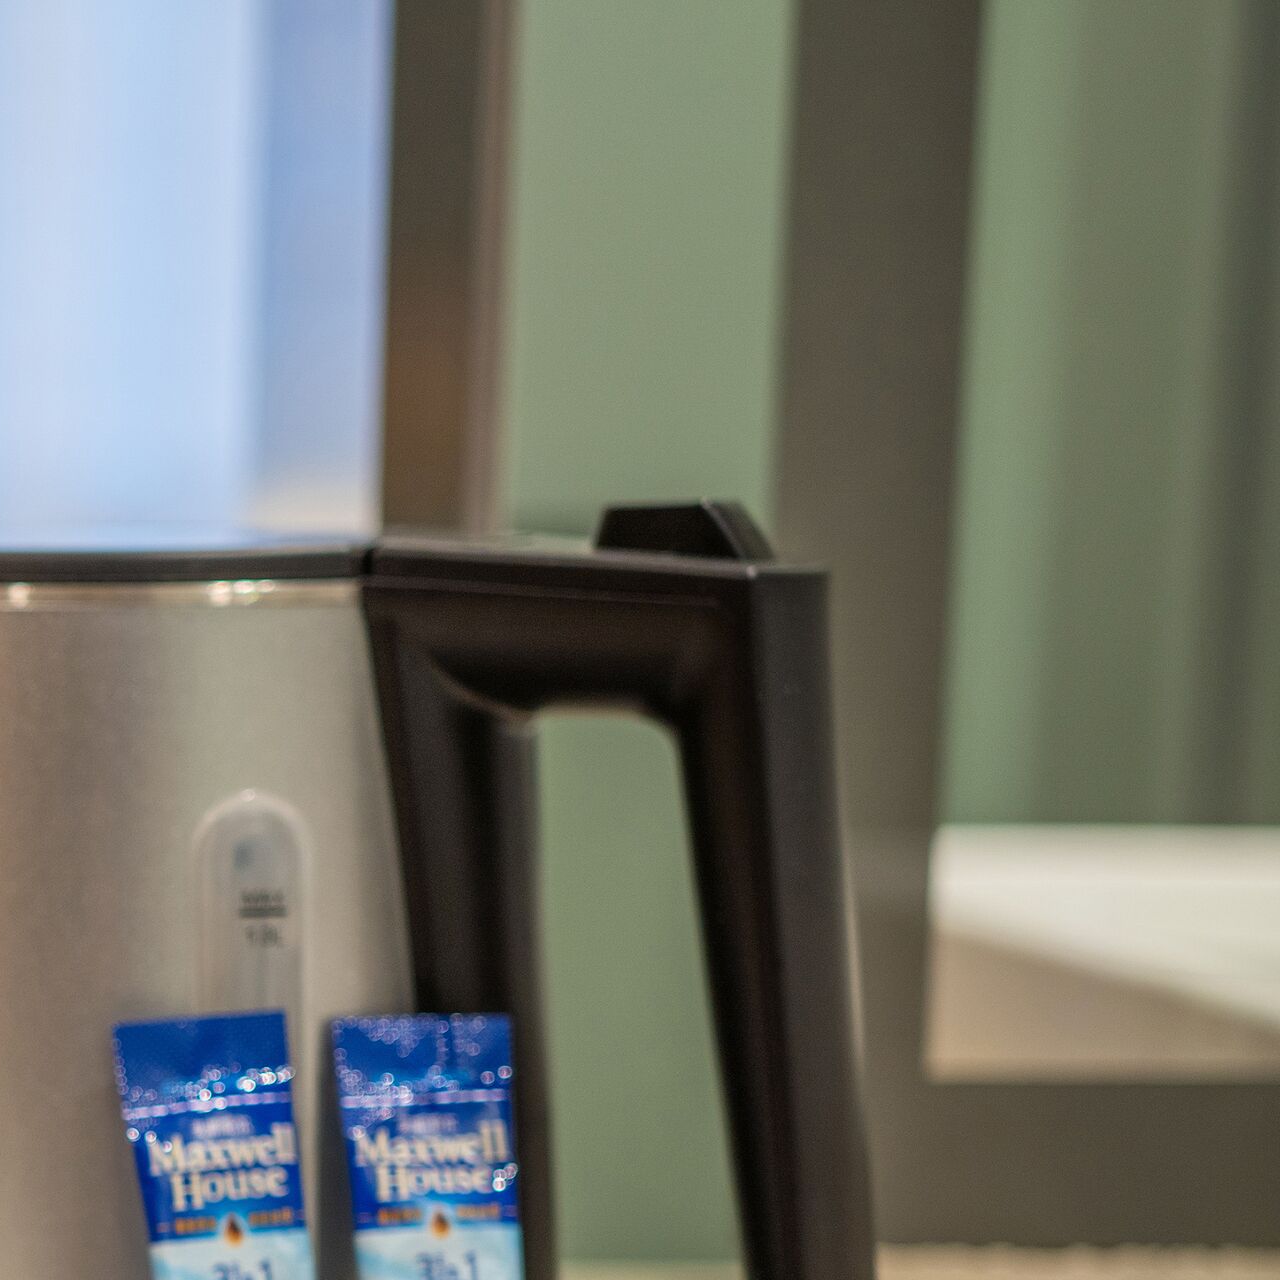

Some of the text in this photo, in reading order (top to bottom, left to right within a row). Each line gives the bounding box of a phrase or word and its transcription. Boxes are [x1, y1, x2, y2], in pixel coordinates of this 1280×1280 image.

[147, 1121, 297, 1176] Maxwell
[353, 1119, 509, 1168] Maxwell
[170, 1167, 289, 1212] House
[376, 1164, 493, 1203] House
